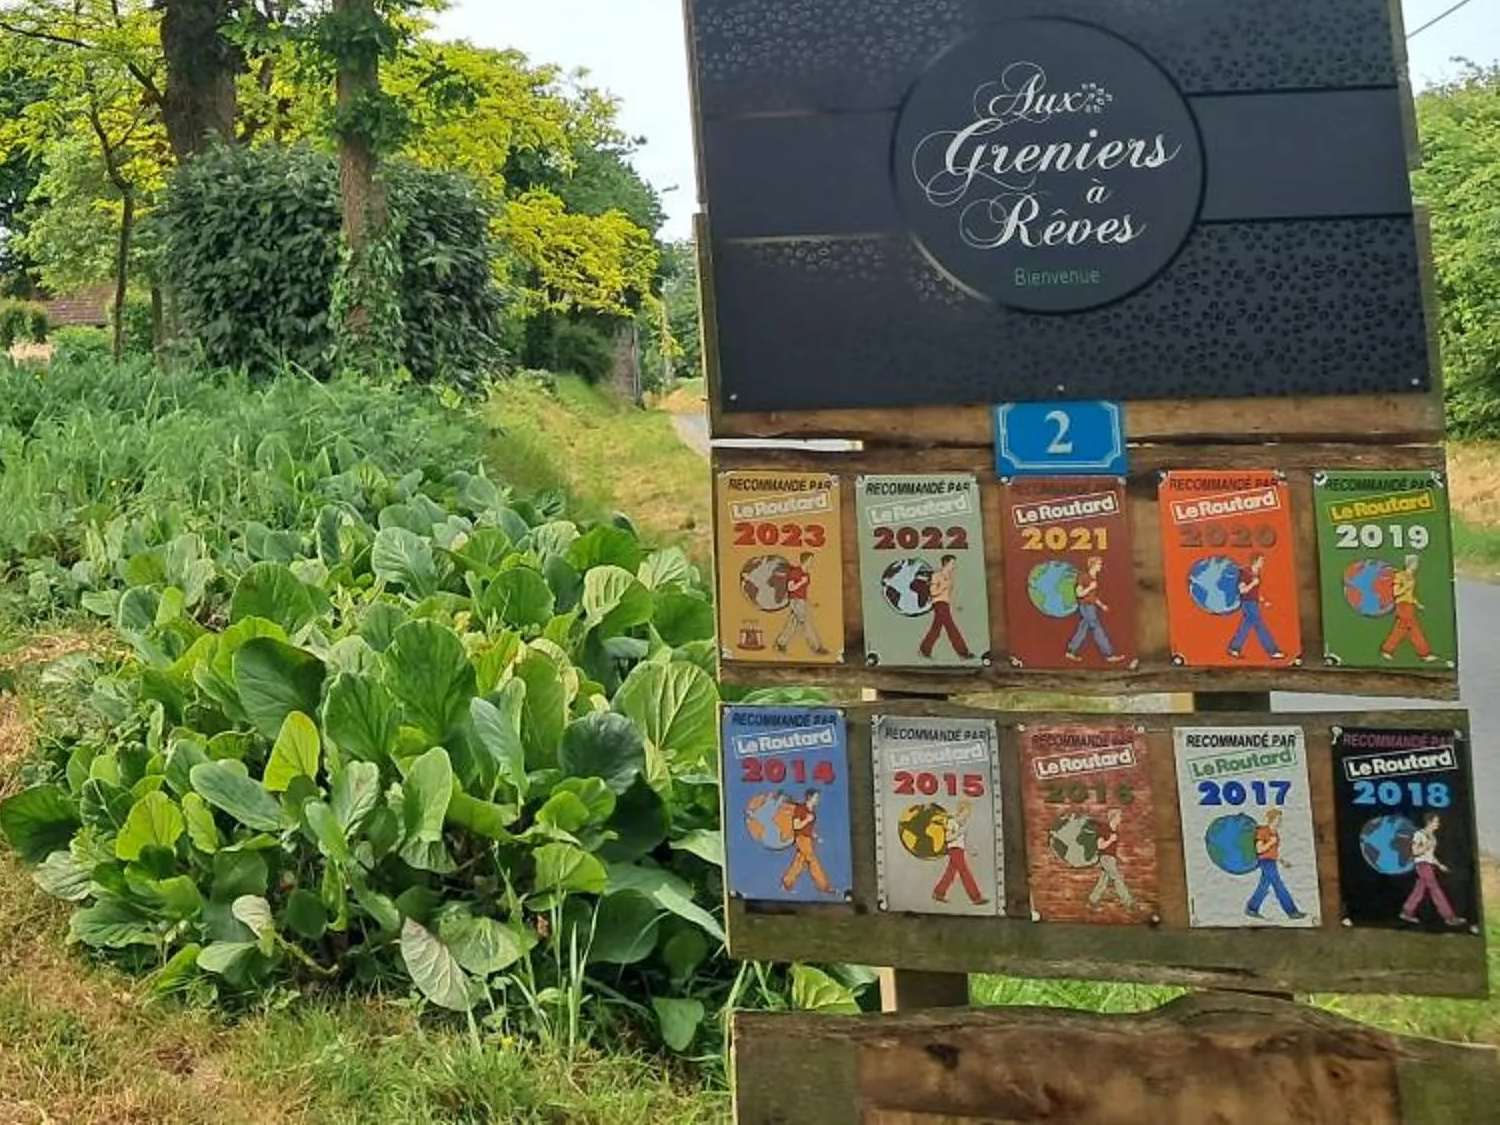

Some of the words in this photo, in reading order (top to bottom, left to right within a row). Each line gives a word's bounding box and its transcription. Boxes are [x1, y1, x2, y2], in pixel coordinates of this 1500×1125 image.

[973, 61, 1086, 123] Aux
[912, 118, 1182, 207] Greniers
[1086, 178, 1111, 203] à
[959, 192, 1148, 250] Rêves
[1015, 268, 1101, 286] Bienvenue
[1045, 410, 1074, 454] 2
[733, 522, 826, 547] 2023
[873, 526, 968, 549] 2022
[1020, 526, 1108, 550] 2021
[1180, 524, 1277, 547] 2020
[1335, 524, 1429, 549] 2019
[1186, 732, 1269, 748] RECOMMANDÉ
[1271, 735, 1296, 747] PAR
[741, 757, 836, 785] 2014
[893, 771, 984, 797] 2015
[1198, 780, 1291, 806] 2017
[1352, 780, 1450, 808] 2018
